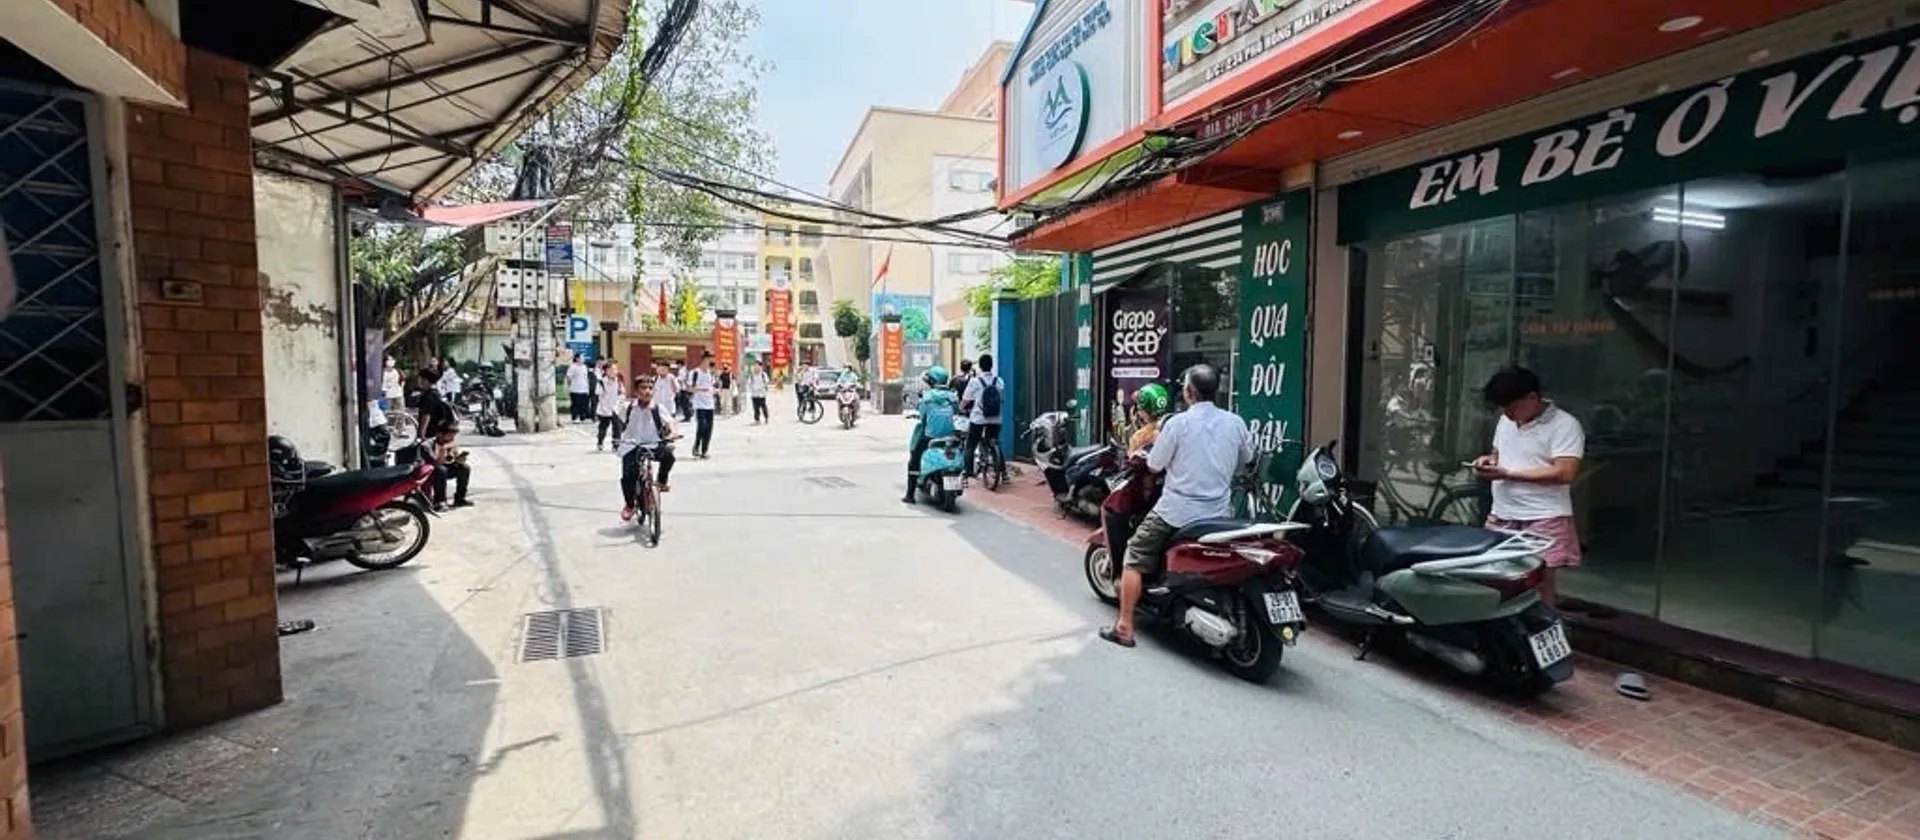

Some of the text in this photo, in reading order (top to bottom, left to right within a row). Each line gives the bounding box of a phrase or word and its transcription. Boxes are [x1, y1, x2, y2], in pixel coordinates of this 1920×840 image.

[1410, 148, 1500, 209] EM
[1253, 240, 1291, 286] HỌC
[569, 317, 588, 339] P
[1113, 309, 1155, 332] Grape
[1250, 303, 1289, 348] QUA
[1250, 354, 1285, 396] ĐÔI
